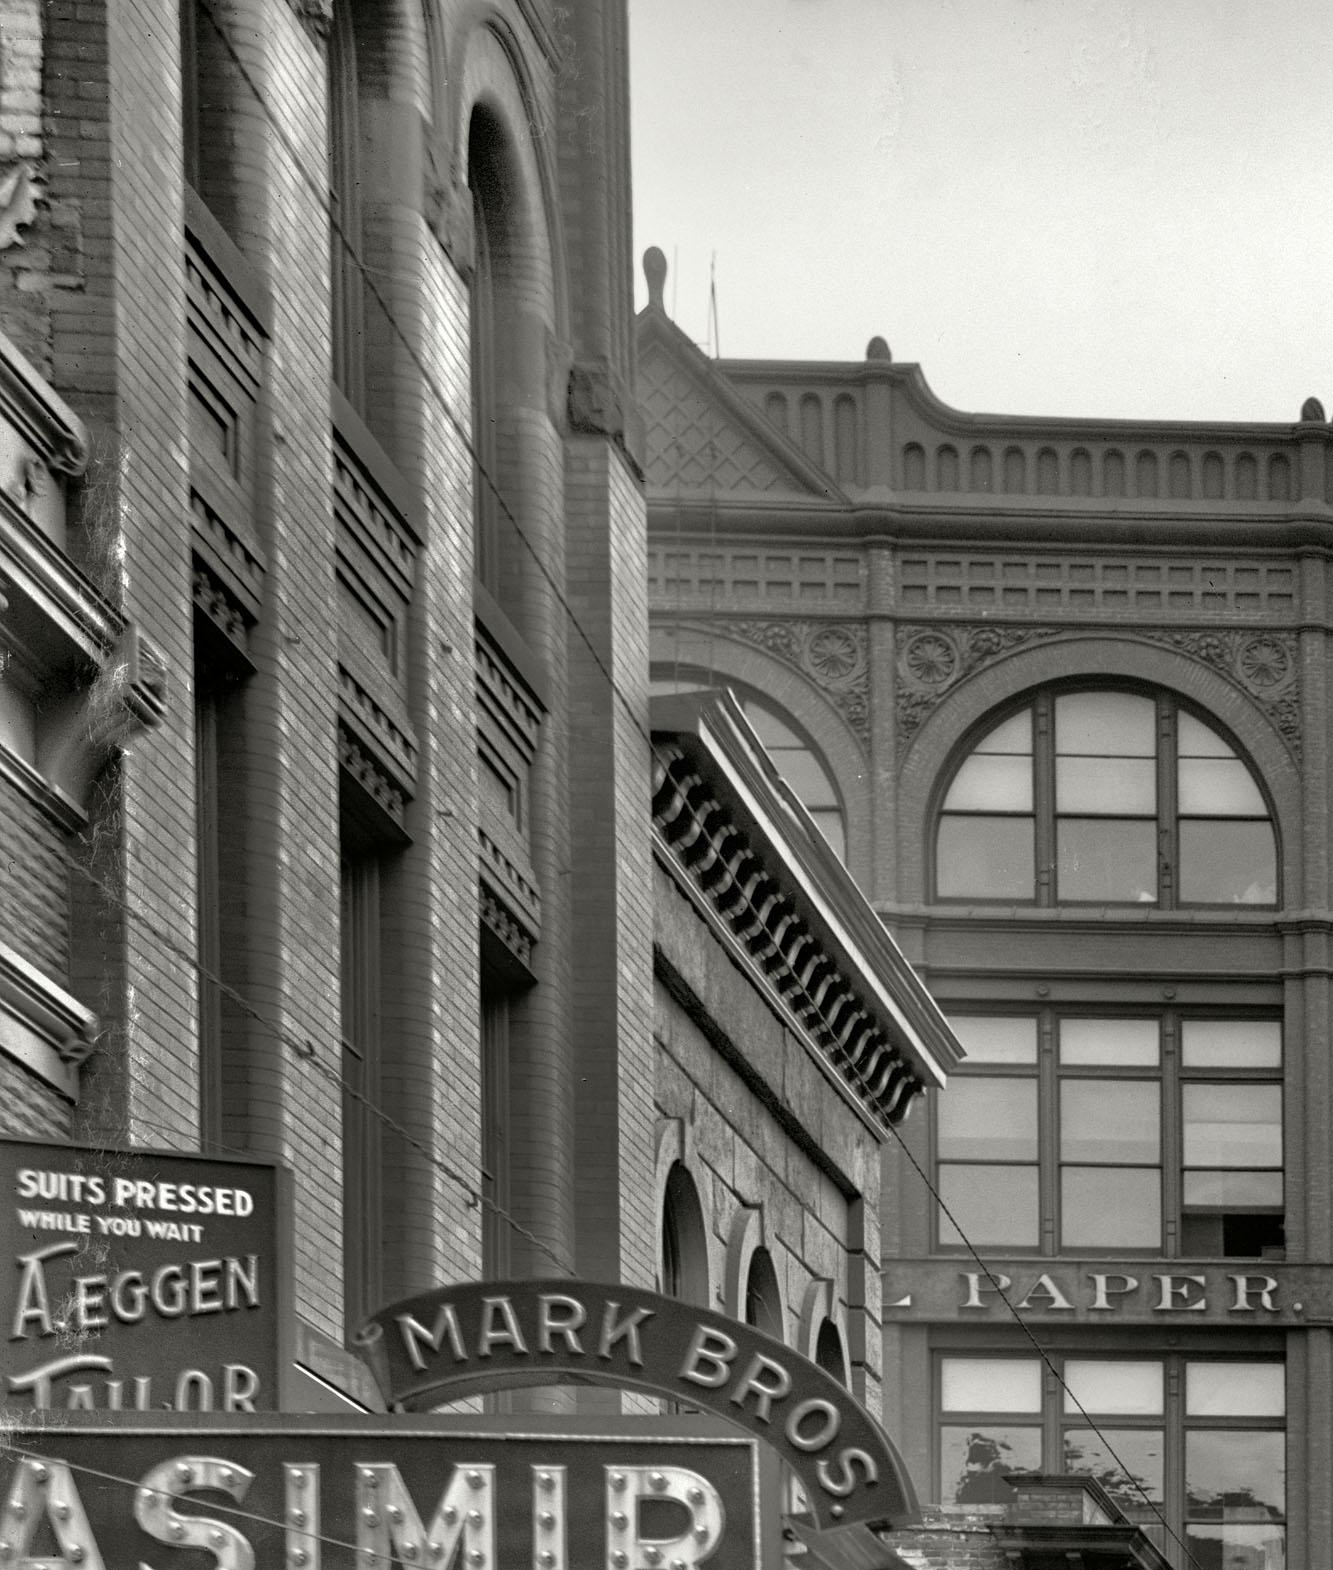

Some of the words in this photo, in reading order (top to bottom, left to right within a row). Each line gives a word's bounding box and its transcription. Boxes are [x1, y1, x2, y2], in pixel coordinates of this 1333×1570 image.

[17, 1168, 106, 1206] SUITS
[114, 1177, 254, 1218] PRESSED
[19, 1211, 92, 1234] WHILE
[96, 1215, 142, 1238] YOU
[146, 1220, 204, 1243] WAIT
[74, 1255, 262, 1328] EGGEN
[958, 1273, 1303, 1312] PAPER.
[397, 1293, 656, 1371] MARK
[683, 1323, 881, 1517] BROS.
